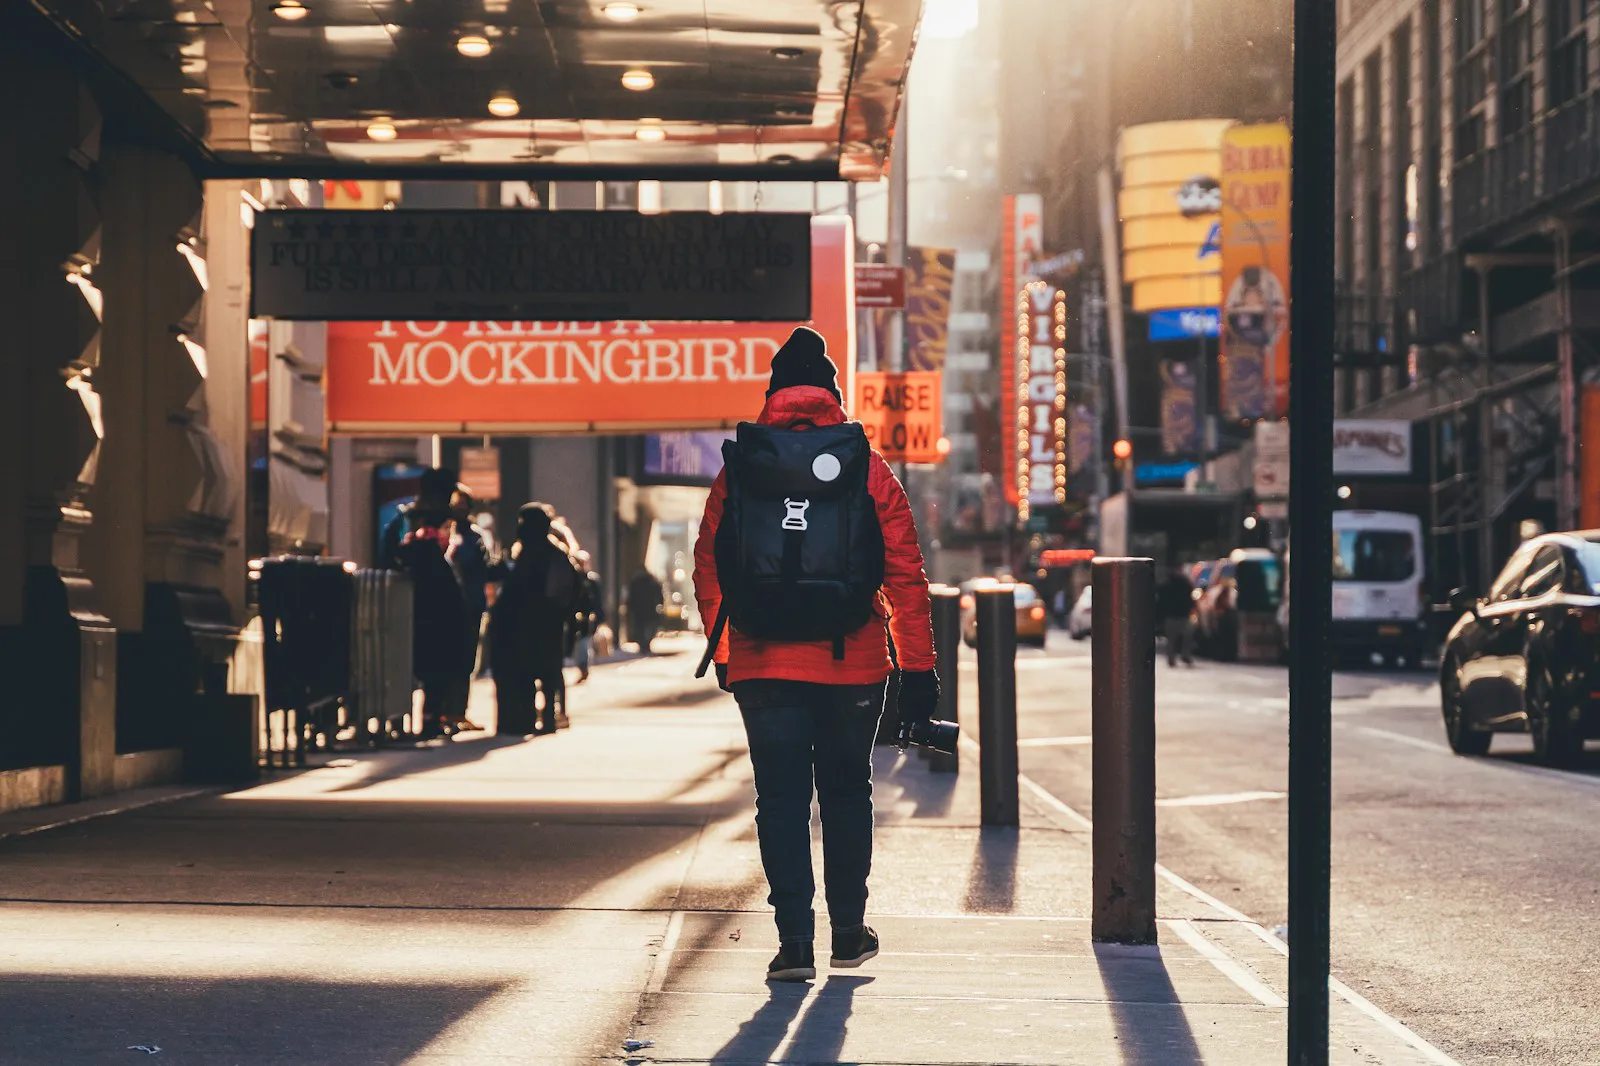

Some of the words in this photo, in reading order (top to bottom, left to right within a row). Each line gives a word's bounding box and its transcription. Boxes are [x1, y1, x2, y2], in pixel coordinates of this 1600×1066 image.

[427, 217, 537, 241] AARON
[702, 217, 777, 242] PLAY
[270, 240, 371, 266] FULLY
[377, 241, 631, 267] DEMONSTRATES
[638, 242, 711, 266] WHY
[718, 242, 794, 267] THIS
[304, 266, 333, 292] IS
[339, 266, 429, 292] STILL
[434, 266, 457, 292] A
[465, 267, 648, 293] NECESSARY
[367, 338, 780, 385] MOCKINGBIRD
[862, 384, 931, 413] RAISE
[864, 422, 932, 452] PLOW
